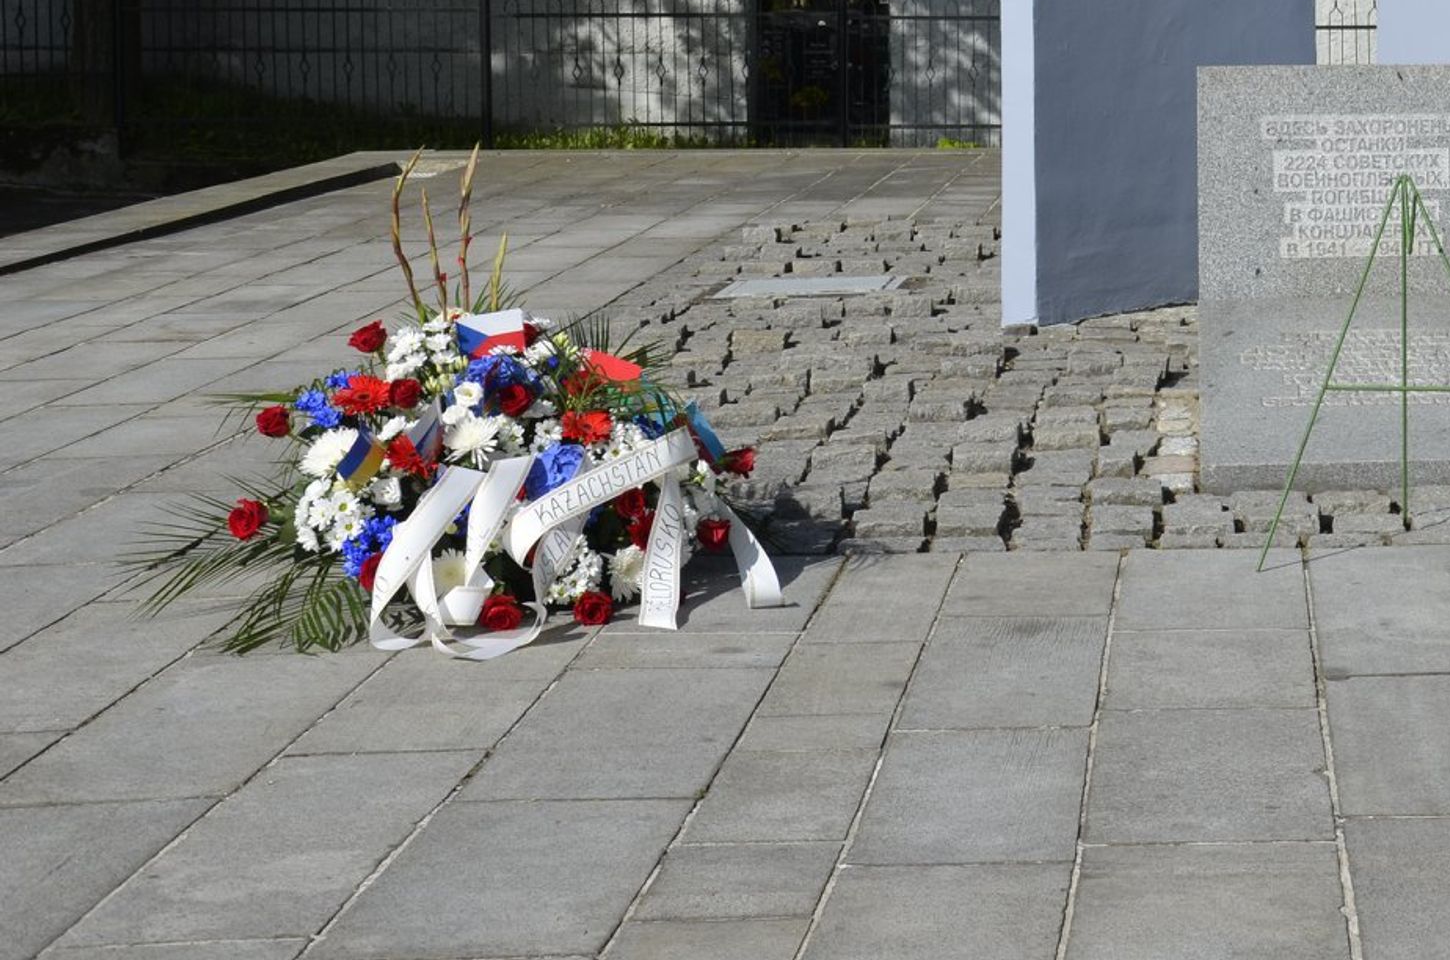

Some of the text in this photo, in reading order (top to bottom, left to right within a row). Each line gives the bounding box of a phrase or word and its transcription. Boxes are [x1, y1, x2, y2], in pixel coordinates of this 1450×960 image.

[1321, 138, 1405, 153] ОСТАНКИ
[1284, 153, 1441, 171] 2224 СОВЕТСКИХ
[533, 447, 664, 527] KAZACHSTAN
